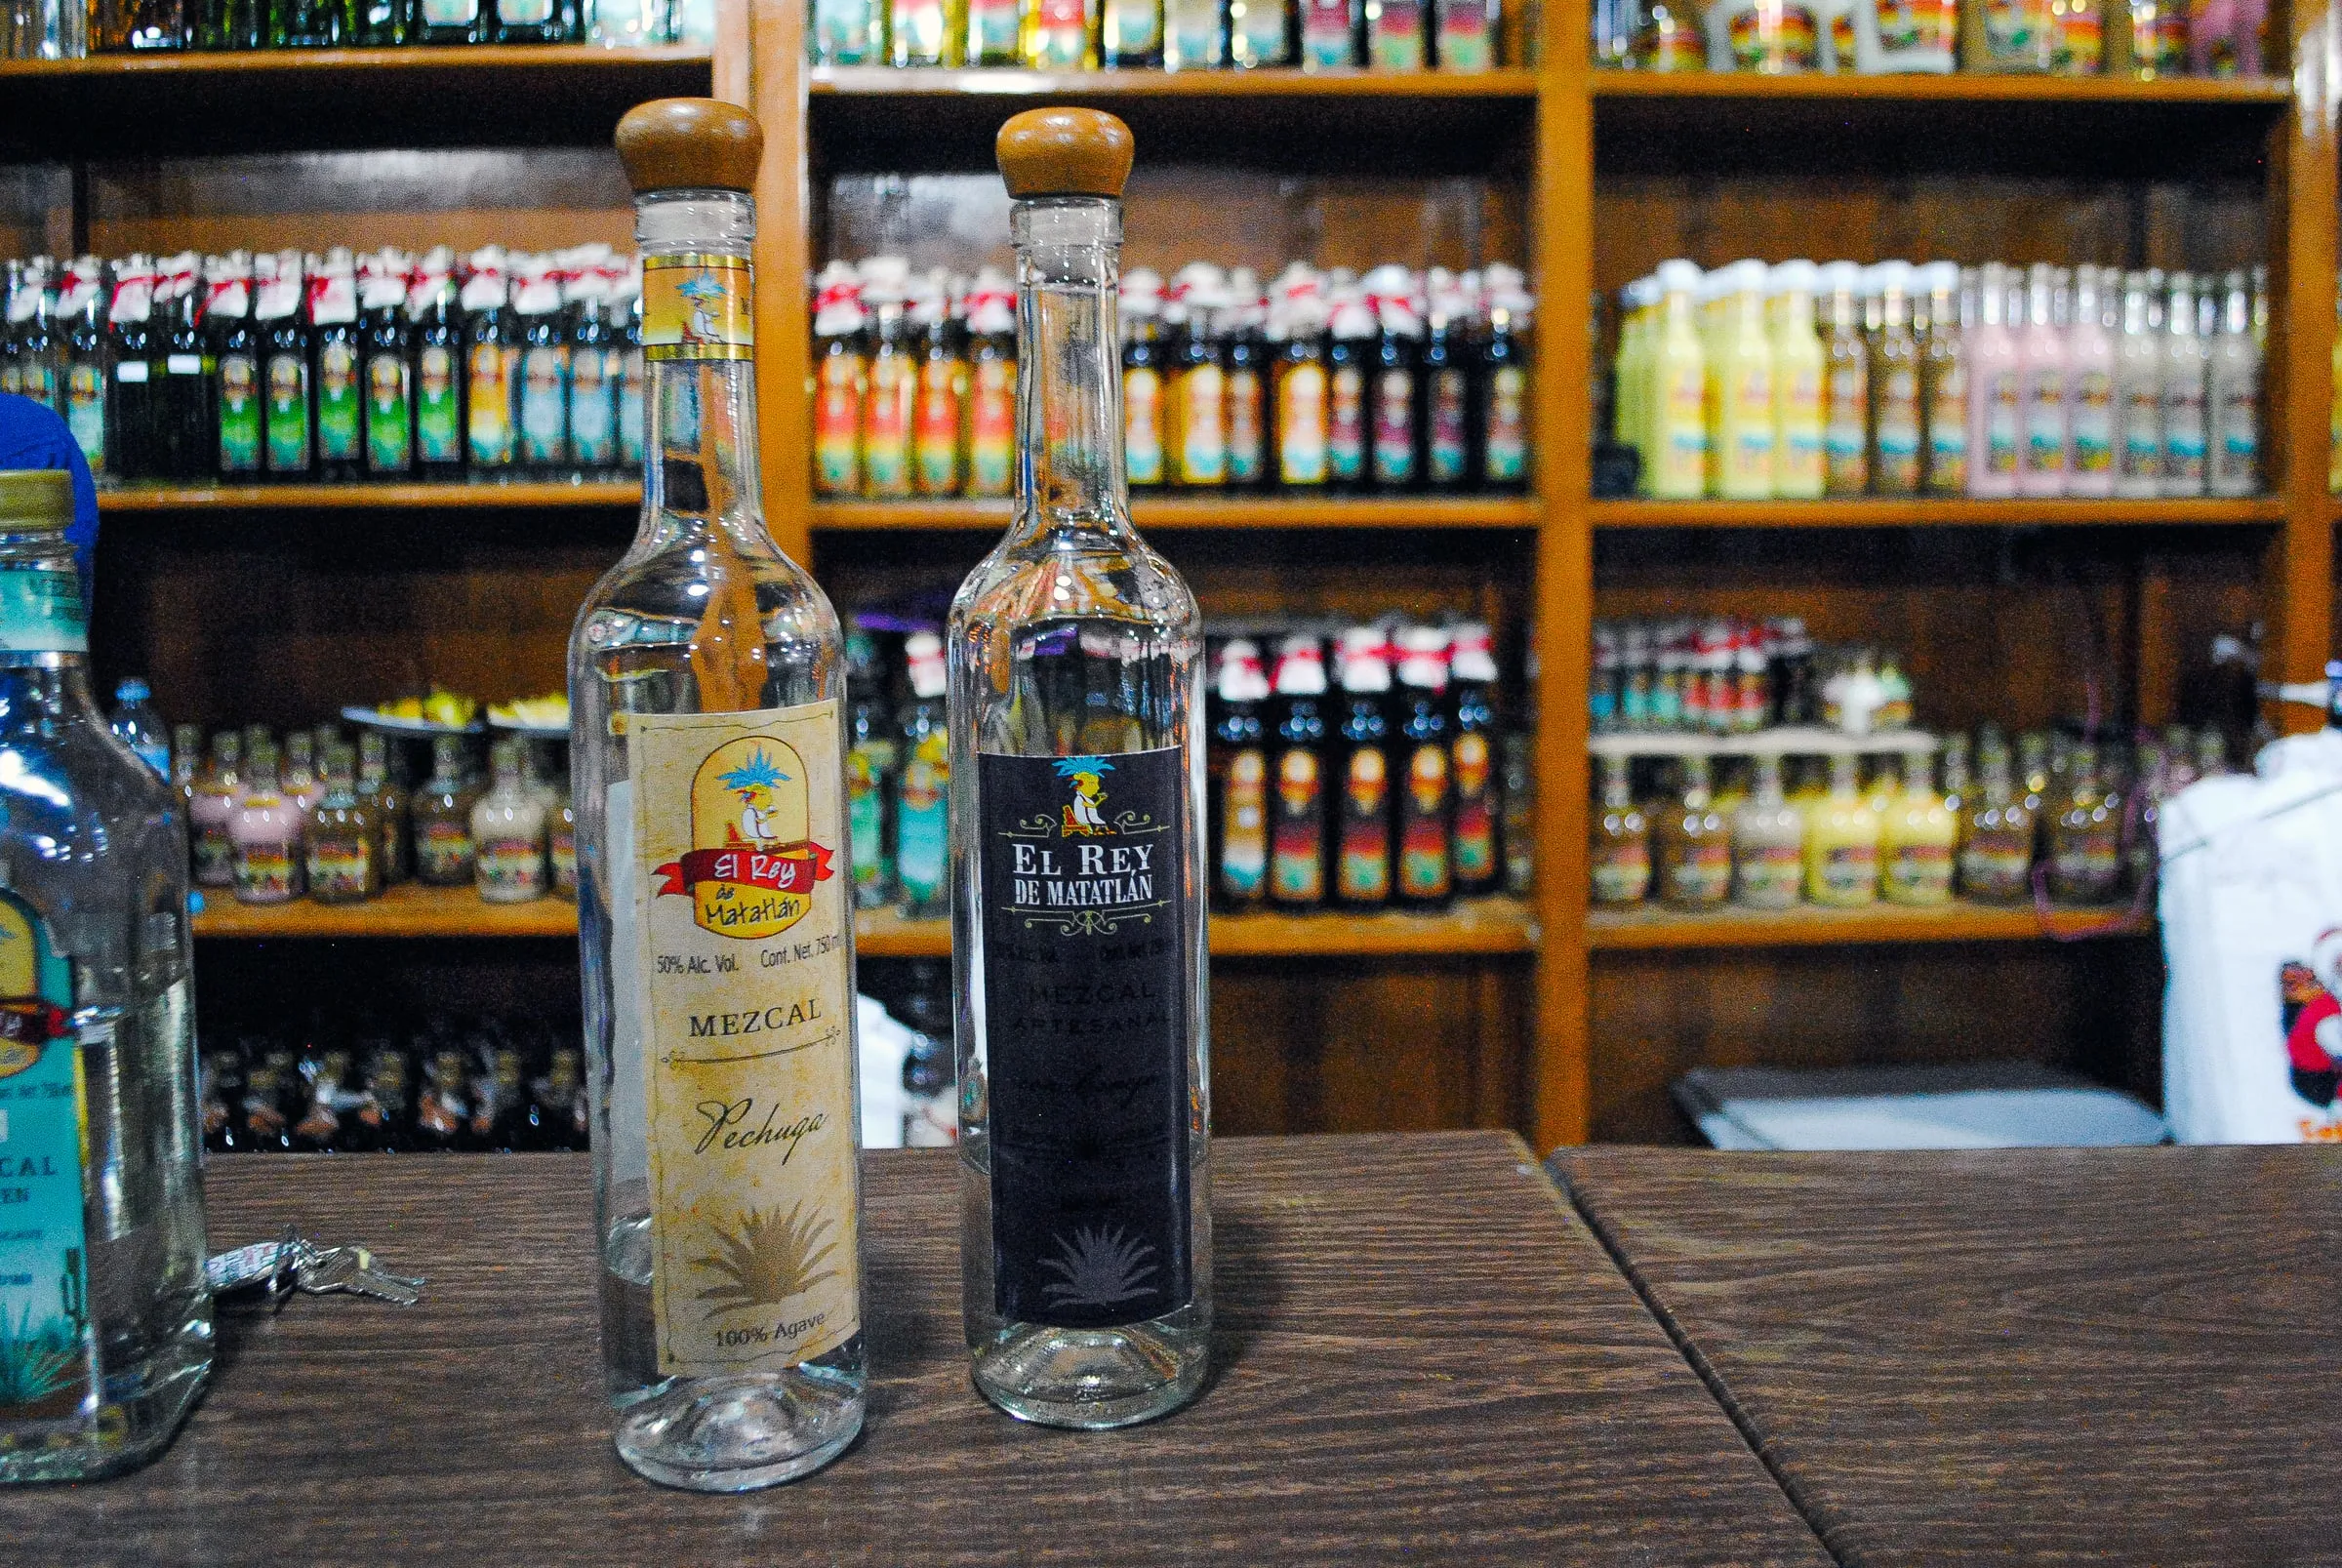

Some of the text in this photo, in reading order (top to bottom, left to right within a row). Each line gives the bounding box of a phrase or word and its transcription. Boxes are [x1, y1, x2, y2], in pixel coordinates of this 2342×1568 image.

[714, 854, 796, 889] El Rey
[1012, 843, 1153, 876] EL REY
[1015, 868, 1152, 906] DE MATATLÁN
[705, 897, 800, 927] Matatlán
[689, 998, 822, 1037] MEZCAL
[693, 1097, 828, 1166] Pechuga
[716, 1311, 826, 1347] 100% Agave
